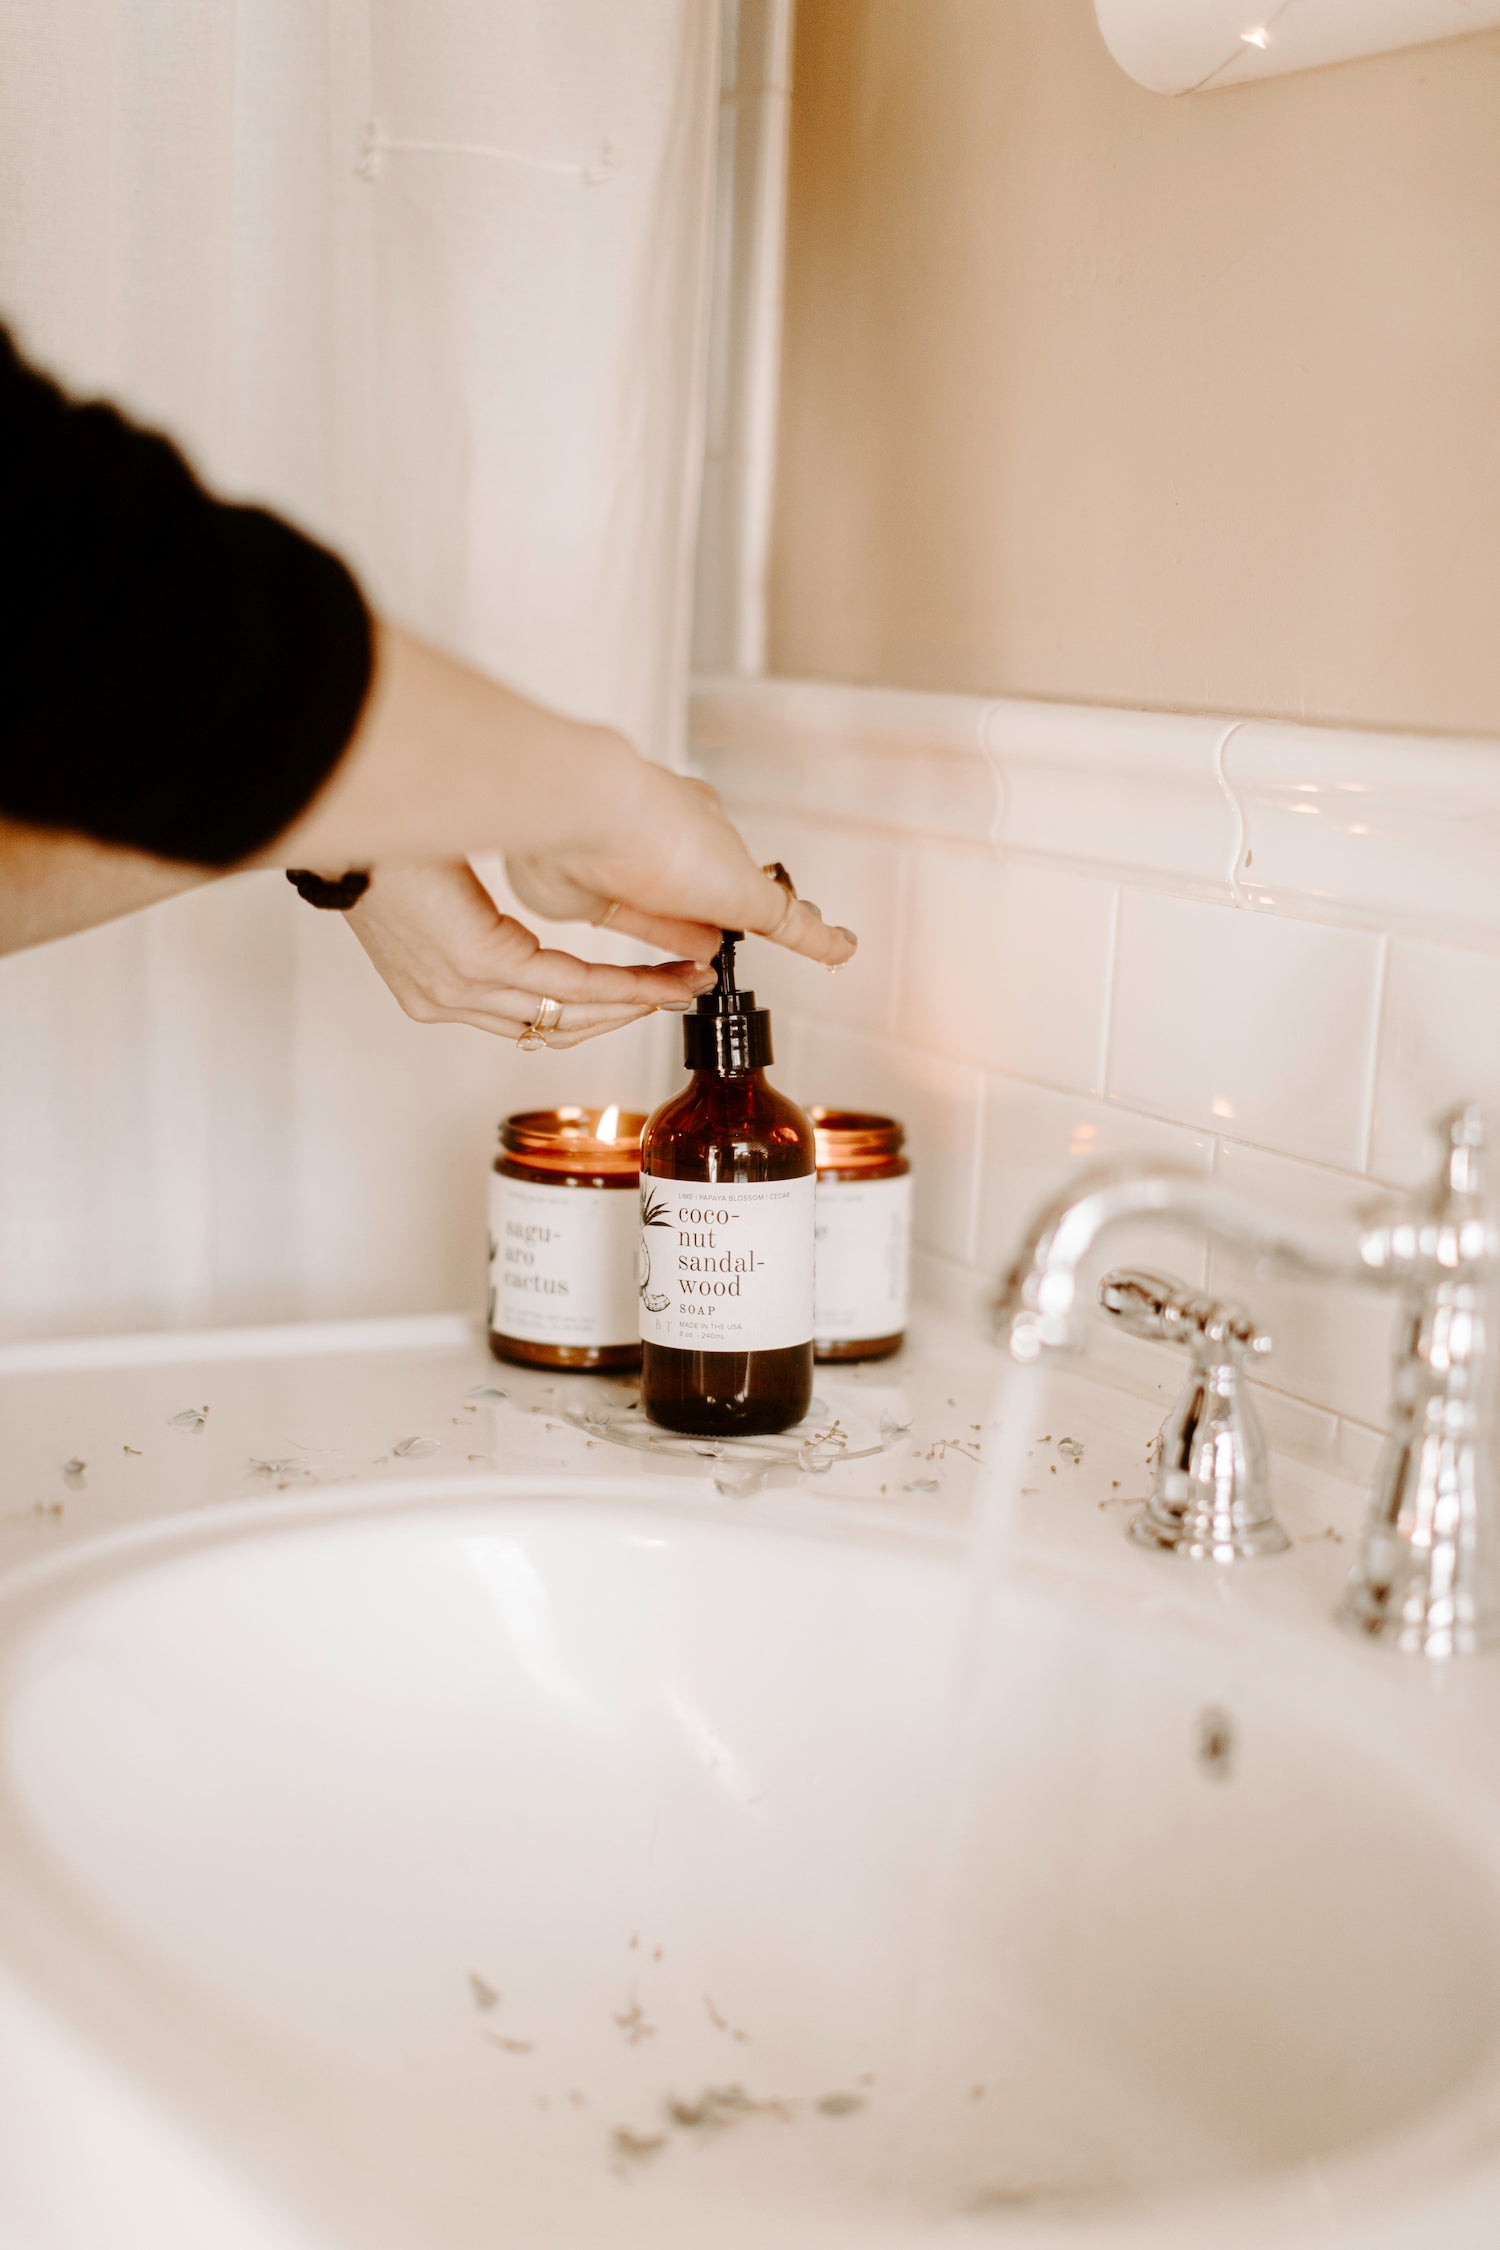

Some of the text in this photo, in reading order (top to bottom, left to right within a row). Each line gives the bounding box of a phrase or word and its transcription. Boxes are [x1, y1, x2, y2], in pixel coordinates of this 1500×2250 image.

[678, 1192, 693, 1200] LIME
[699, 1193, 726, 1202] PAPAYA
[728, 1194, 764, 1202] BLOSSOM
[769, 1191, 790, 1200] CEDAR
[678, 1207, 740, 1225] coco-
[505, 1220, 561, 1246] sagu-
[679, 1229, 717, 1249] nut
[505, 1246, 535, 1266] aro
[678, 1250, 765, 1273] sandal-
[504, 1271, 570, 1296] cactus
[678, 1275, 742, 1297] wood
[679, 1303, 716, 1316] SOAP
[679, 1321, 743, 1331] MADE IN THE USA
